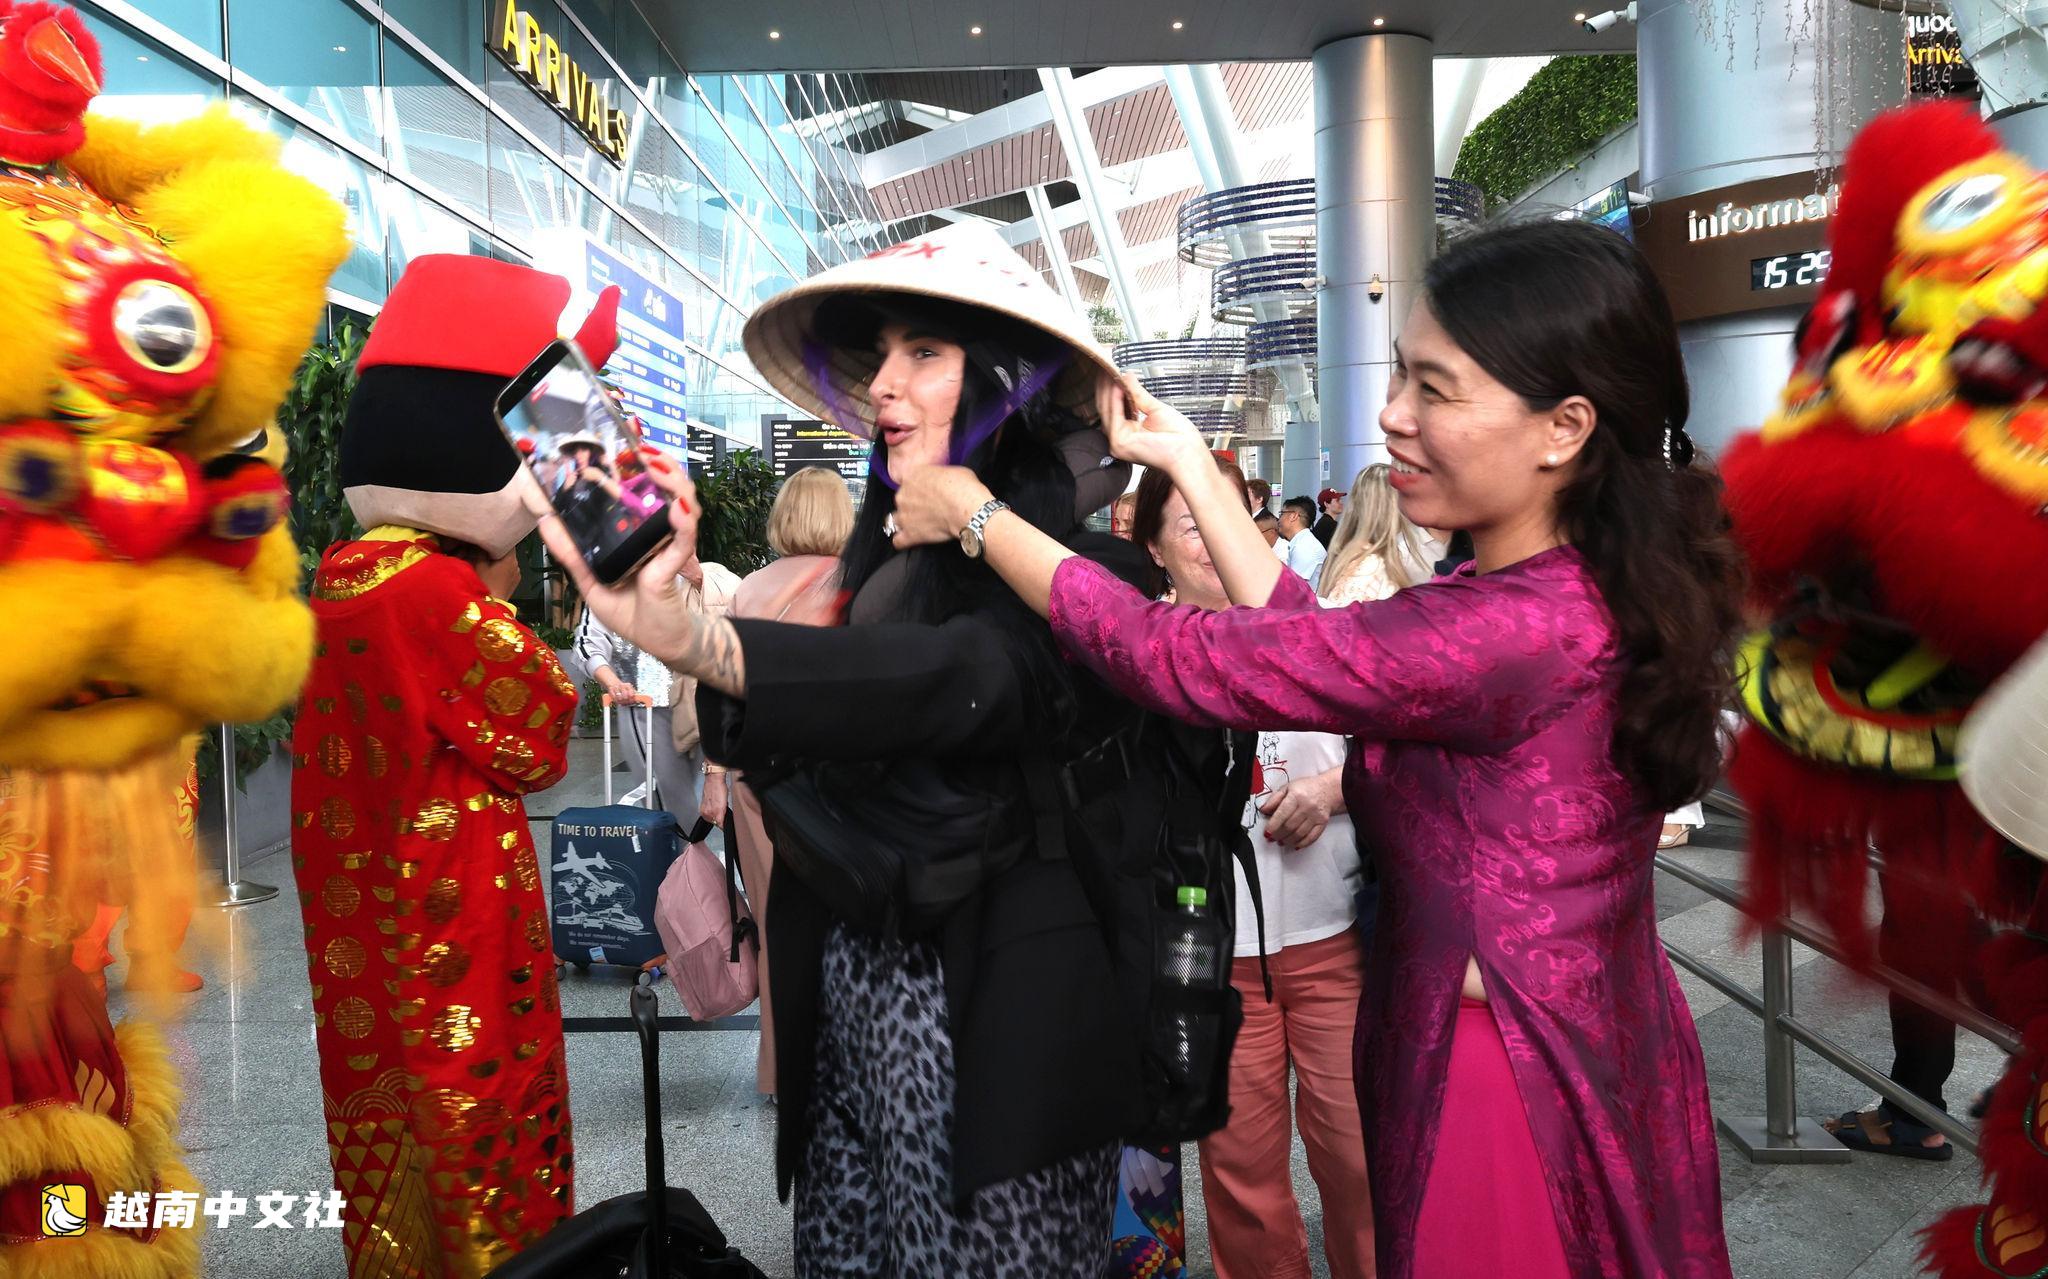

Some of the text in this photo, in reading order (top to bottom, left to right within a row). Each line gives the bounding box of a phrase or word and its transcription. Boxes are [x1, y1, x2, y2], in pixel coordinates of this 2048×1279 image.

[503, 0, 627, 162] ARRIVALS
[558, 824, 637, 837] TIME TO TRAVEL
